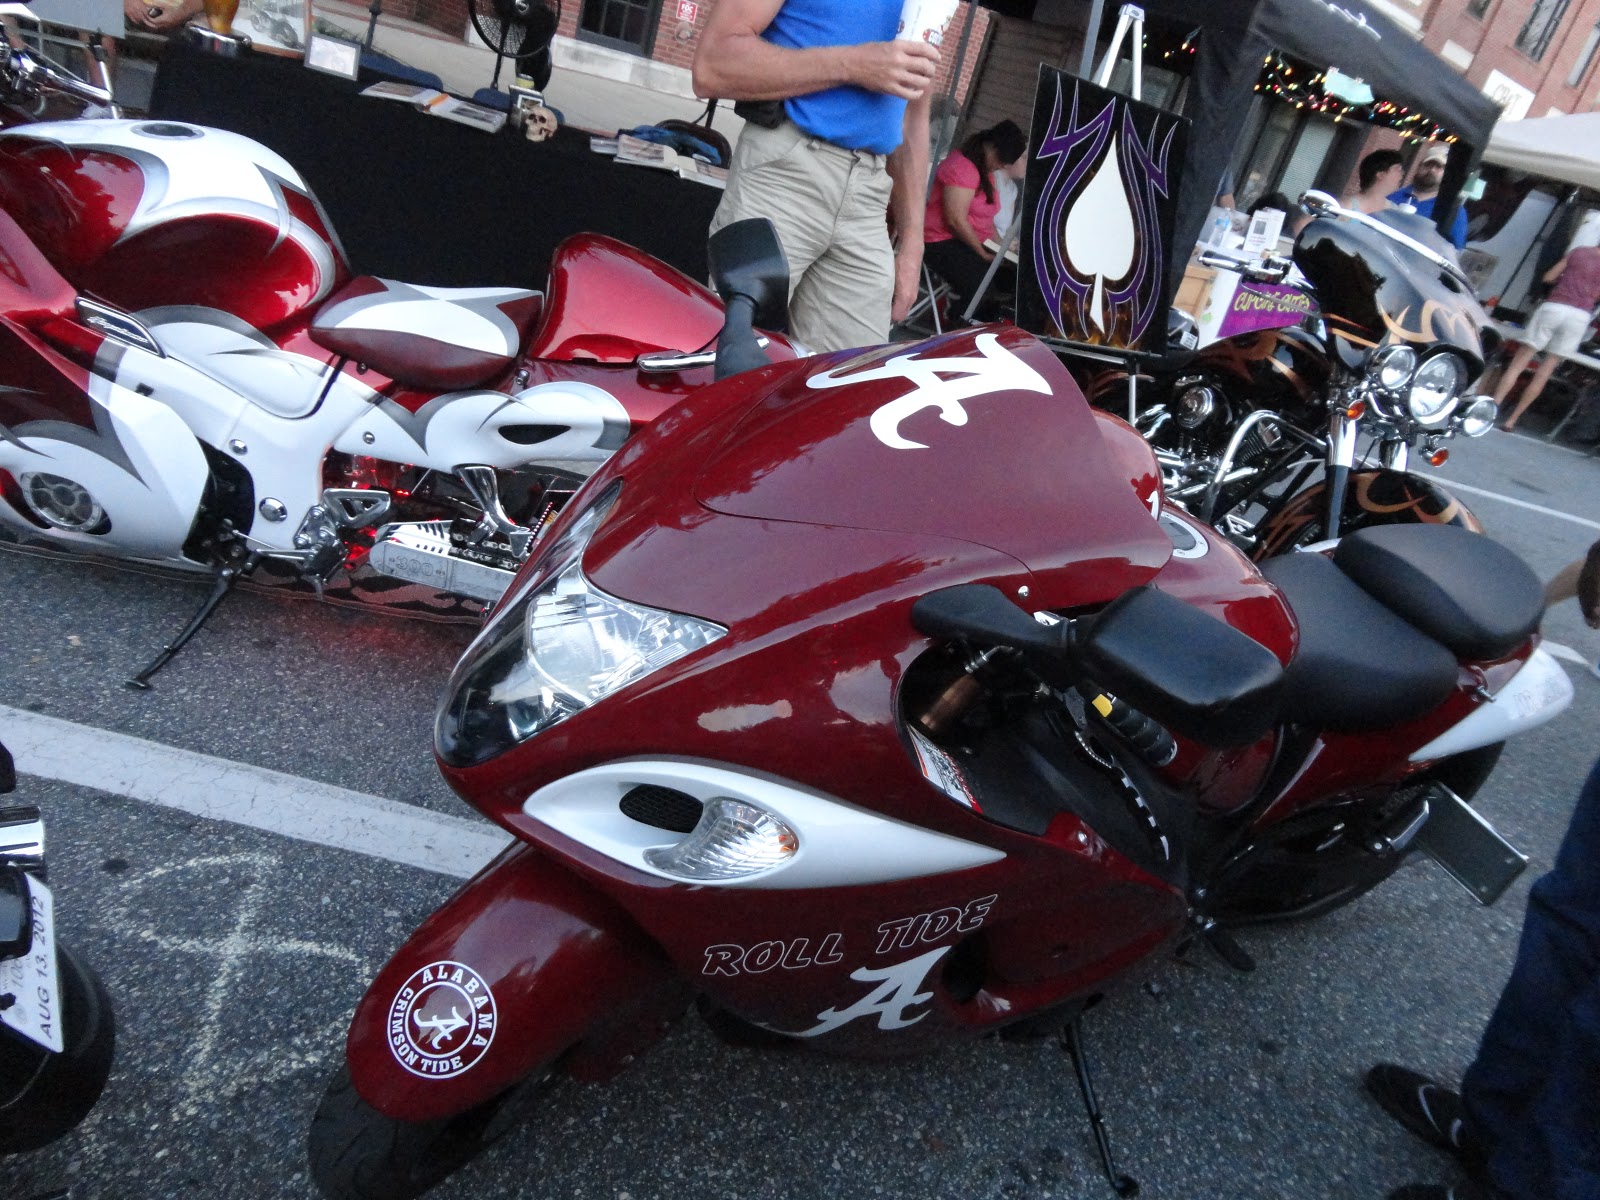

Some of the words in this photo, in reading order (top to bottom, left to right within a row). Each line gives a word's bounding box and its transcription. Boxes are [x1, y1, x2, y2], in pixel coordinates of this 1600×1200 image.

[395, 555, 434, 577] 300
[32, 896, 46, 946] 2012
[701, 933, 844, 976] ROLL
[875, 893, 998, 954] TIDE
[37, 986, 53, 1040] AUG
[391, 987, 419, 1066] CRIMSON
[420, 1055, 464, 1073] TIDE
[422, 965, 493, 1047] ALABAMA
